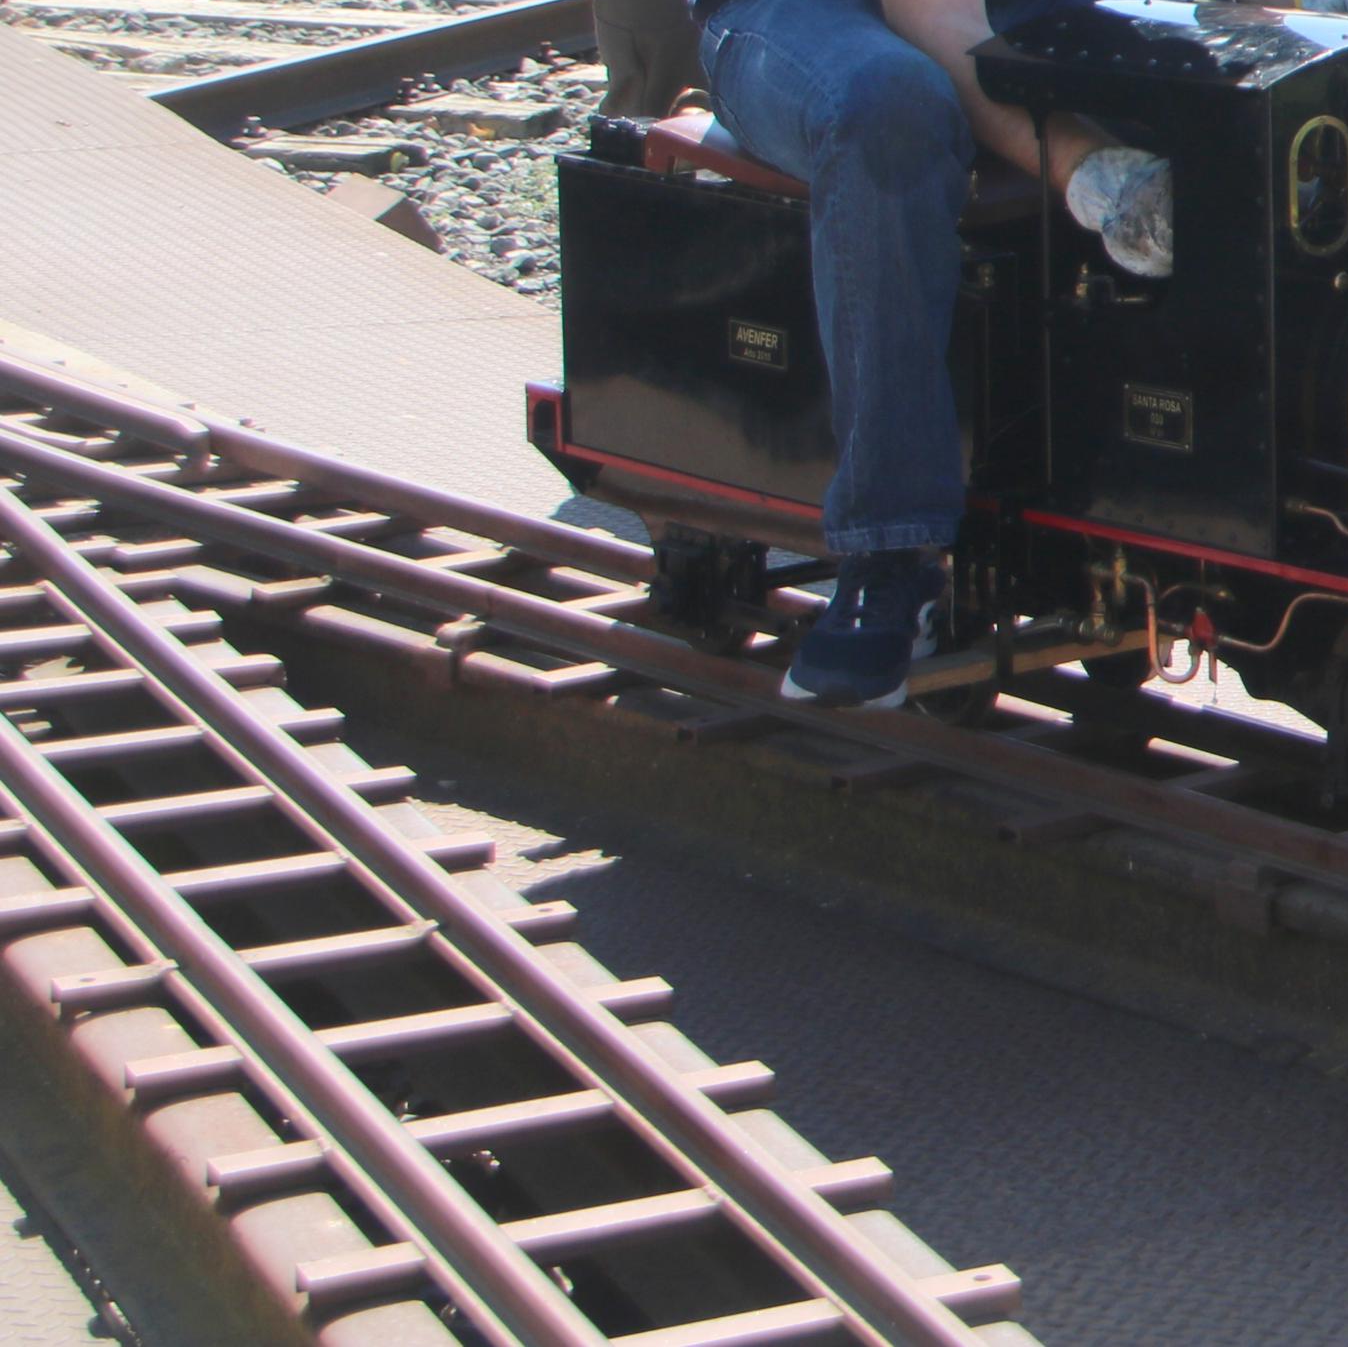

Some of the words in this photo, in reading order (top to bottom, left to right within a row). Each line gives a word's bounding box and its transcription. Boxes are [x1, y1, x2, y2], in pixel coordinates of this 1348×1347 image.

[736, 326, 779, 349] AVENFER
[1132, 393, 1157, 409] SANTA
[1159, 399, 1182, 413] ROSA
